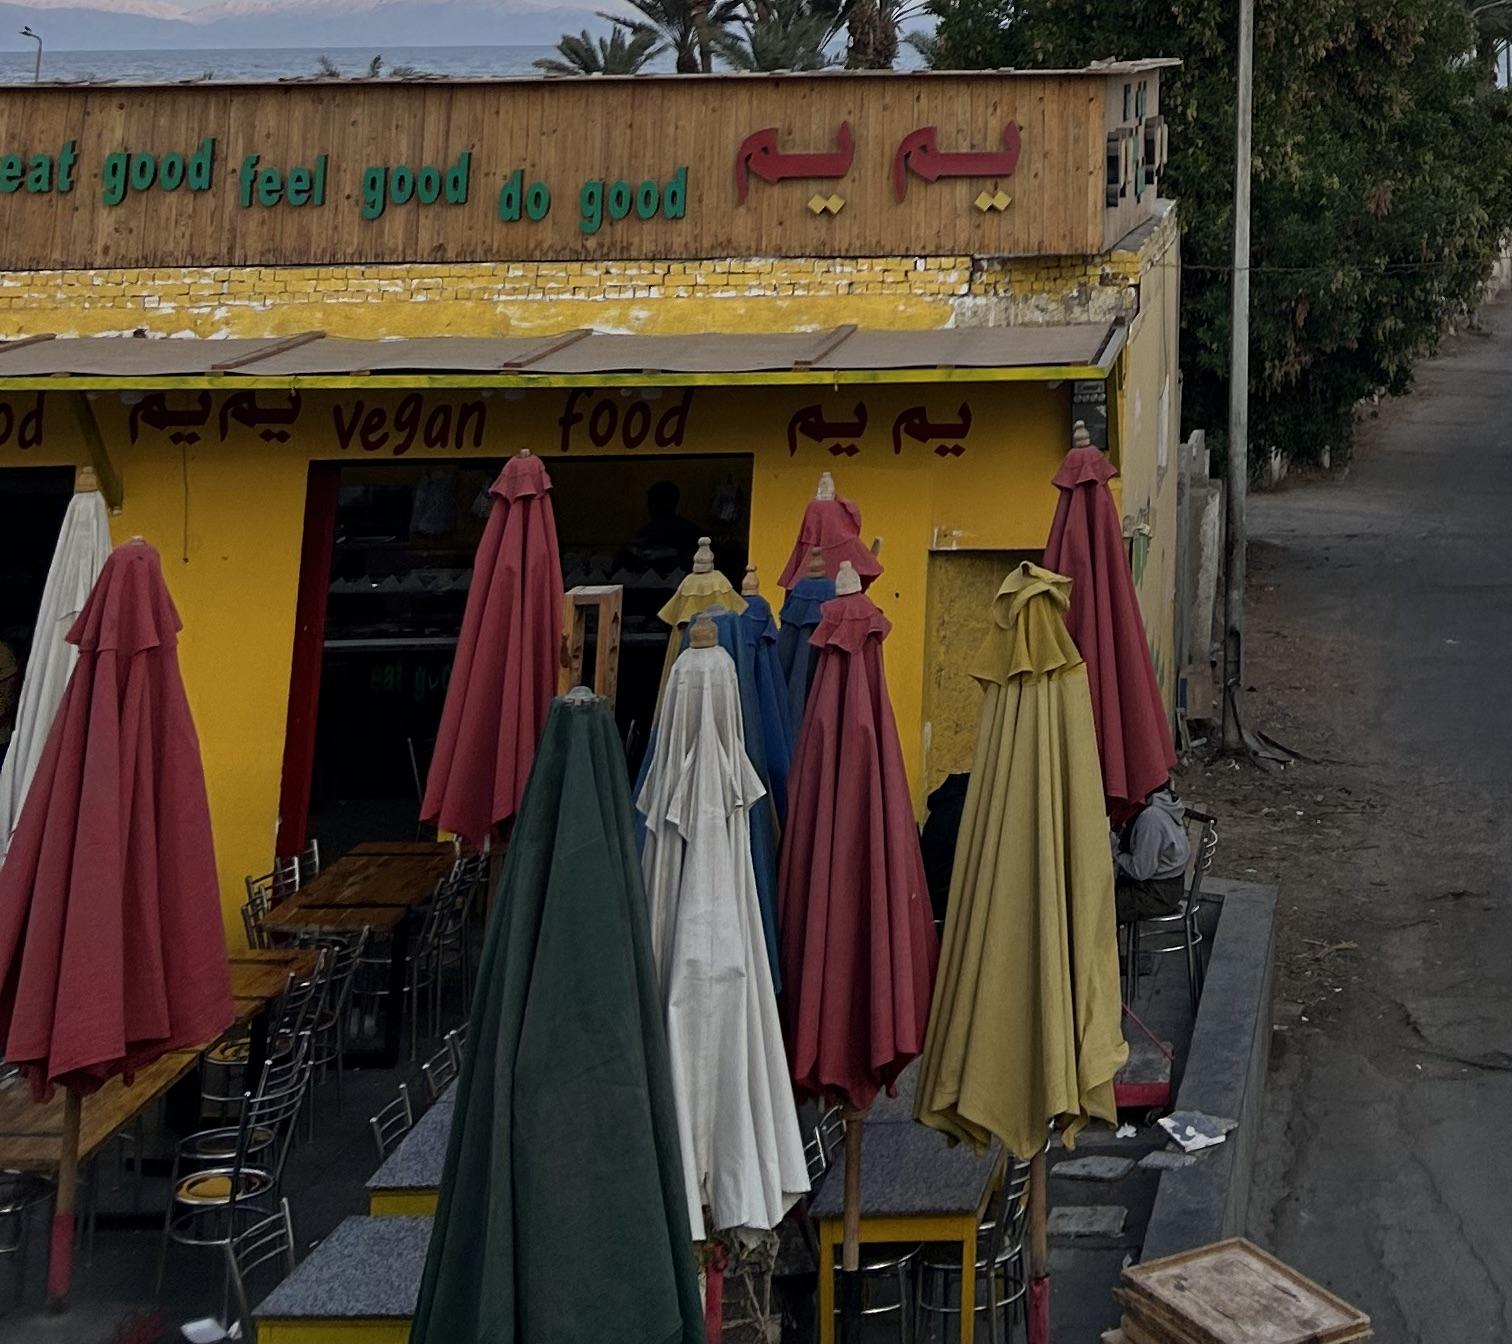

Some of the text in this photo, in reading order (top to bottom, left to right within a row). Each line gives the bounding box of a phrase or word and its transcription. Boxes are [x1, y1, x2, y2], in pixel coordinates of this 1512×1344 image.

[0, 139, 687, 234] eat good feel good do good
[735, 121, 855, 216] يم
[894, 121, 1022, 212] يم
[129, 390, 303, 446] يم يم
[332, 390, 691, 456] vegan food
[787, 401, 973, 458] يم يم
